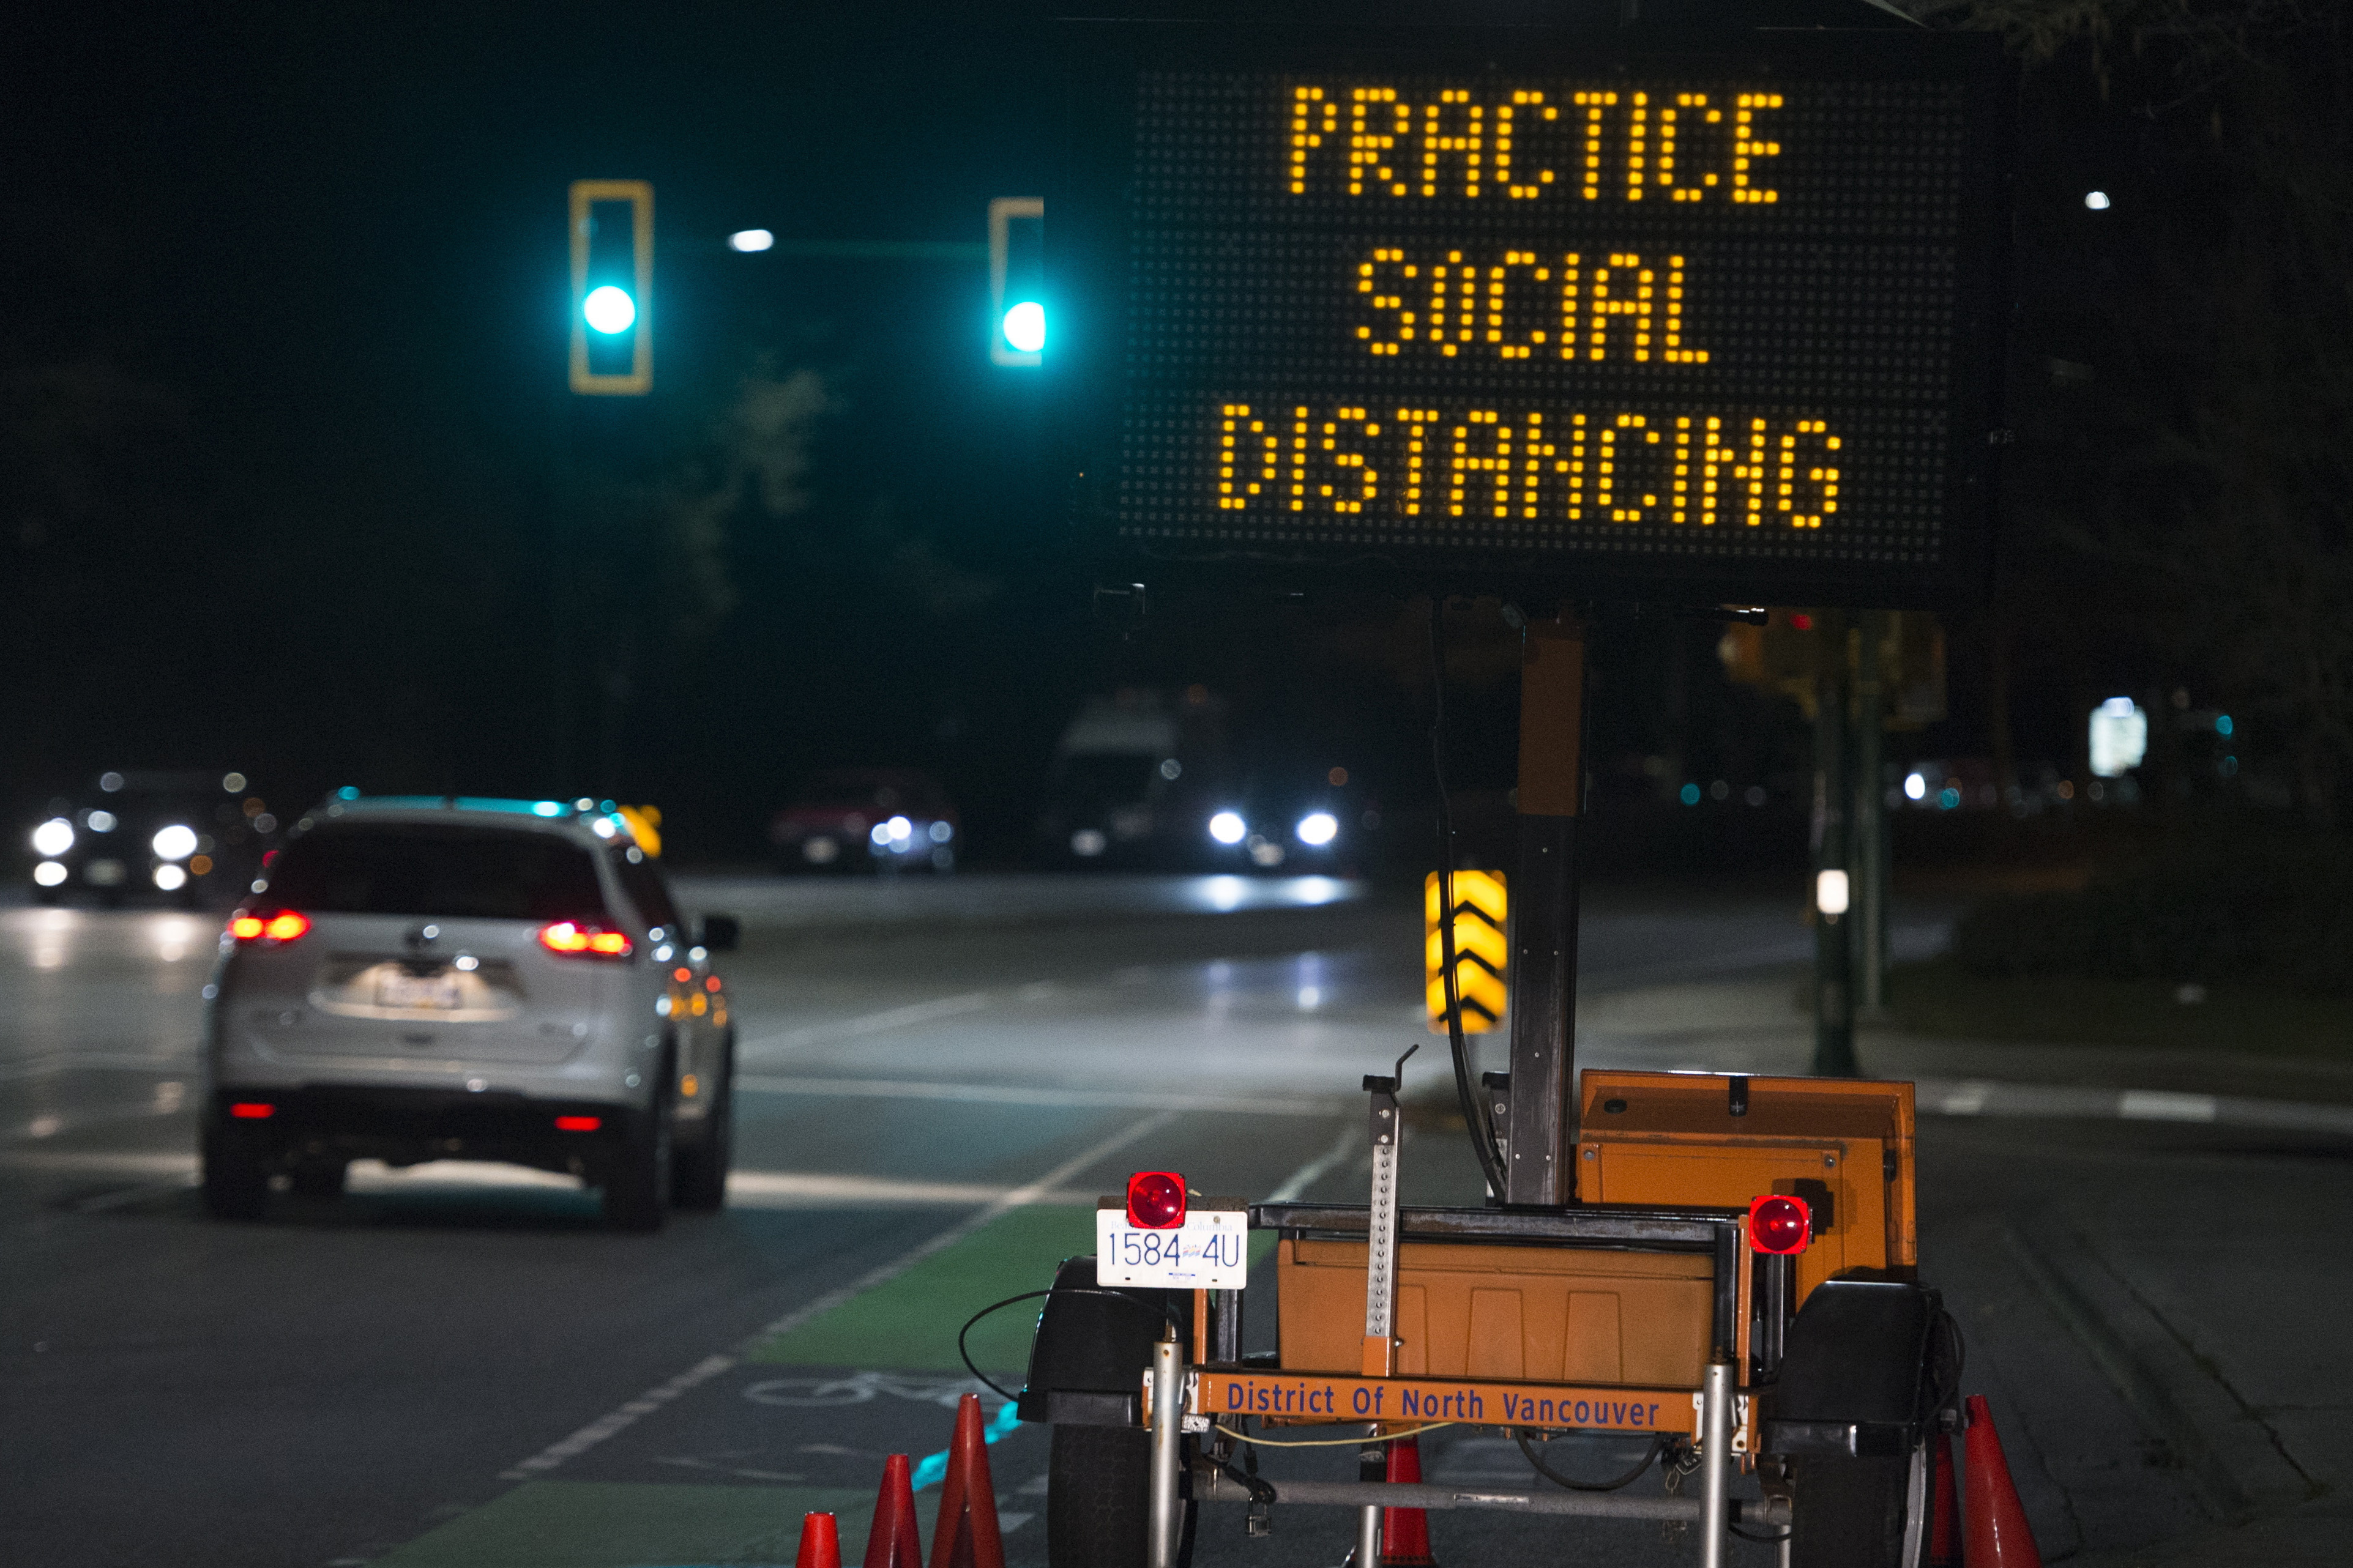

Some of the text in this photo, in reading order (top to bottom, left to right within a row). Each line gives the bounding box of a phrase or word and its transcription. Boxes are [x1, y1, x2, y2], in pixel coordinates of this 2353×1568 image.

[1288, 84, 1784, 205] PRACTICE
[1354, 246, 1710, 365] SOCIAL
[1217, 402, 1843, 530] DISTANCING
[1109, 1232, 1239, 1268] 1584 4U
[1187, 1222, 1232, 1232] Columbia
[1228, 1381, 1659, 1426] District Of North Vancouver
